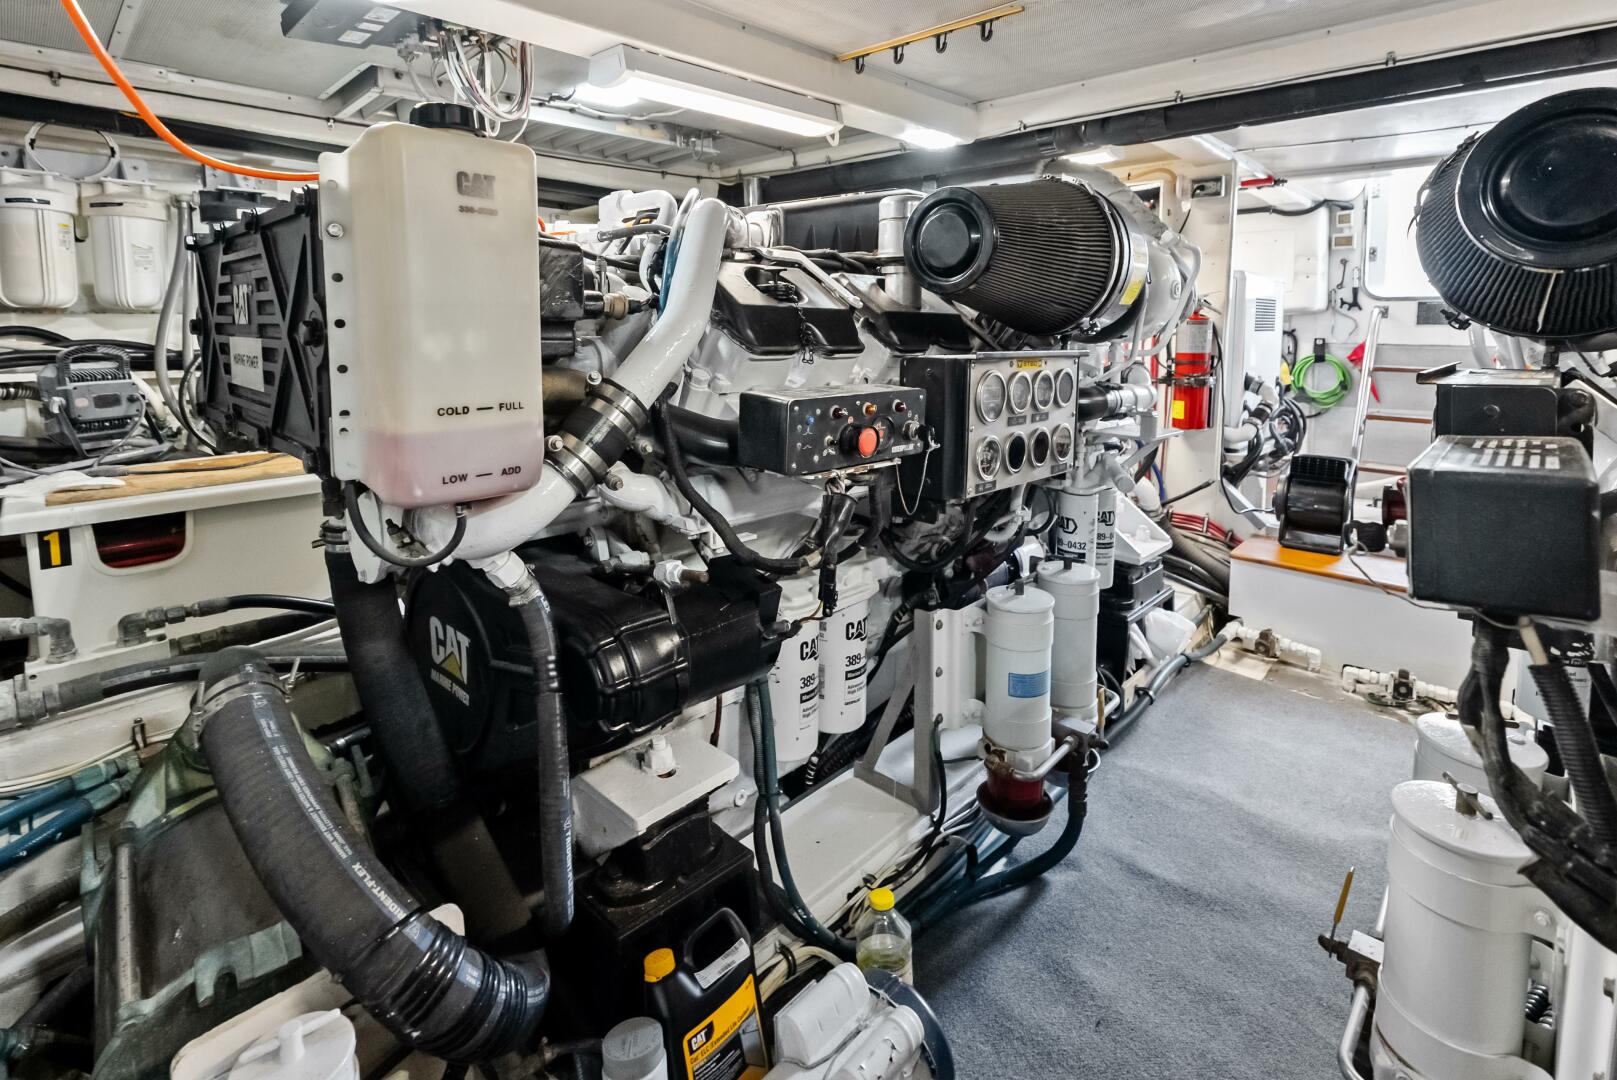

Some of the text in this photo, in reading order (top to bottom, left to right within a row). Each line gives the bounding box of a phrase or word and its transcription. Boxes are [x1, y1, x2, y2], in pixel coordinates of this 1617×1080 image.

[457, 171, 496, 200] CAT
[233, 285, 248, 325] CAT
[437, 402, 524, 416] COLD FULL
[442, 466, 522, 485] LOW ADD
[43, 531, 62, 566] 1
[430, 616, 470, 685] CAT
[352, 862, 407, 920] RIDENT-FLEX
[691, 1028, 708, 1051] CAT
